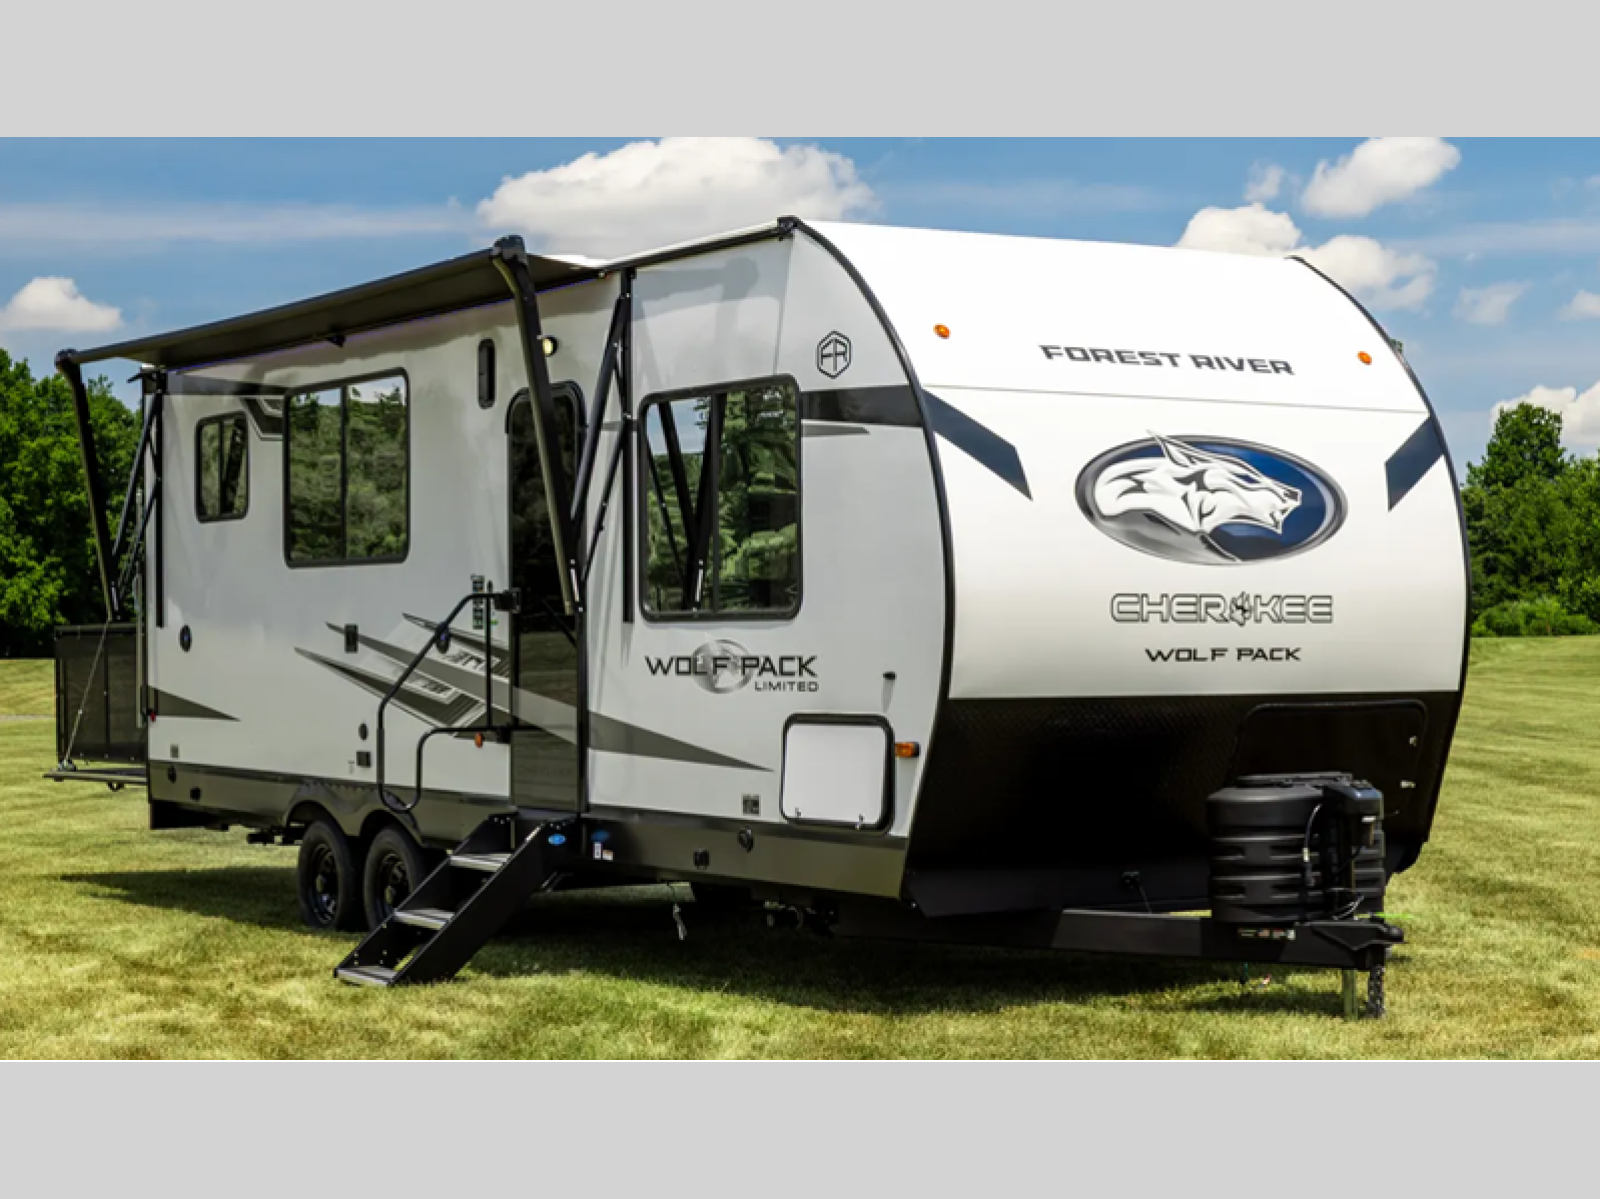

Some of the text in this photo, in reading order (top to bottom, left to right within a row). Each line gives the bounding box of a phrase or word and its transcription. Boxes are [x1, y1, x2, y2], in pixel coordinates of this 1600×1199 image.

[1039, 344, 1295, 375] FOREST RIVER
[1111, 592, 1333, 627] CHEROKEE
[644, 655, 818, 678] WOLF PACK
[1145, 648, 1302, 662] WOLF PACK
[754, 680, 820, 693] LIMITED
